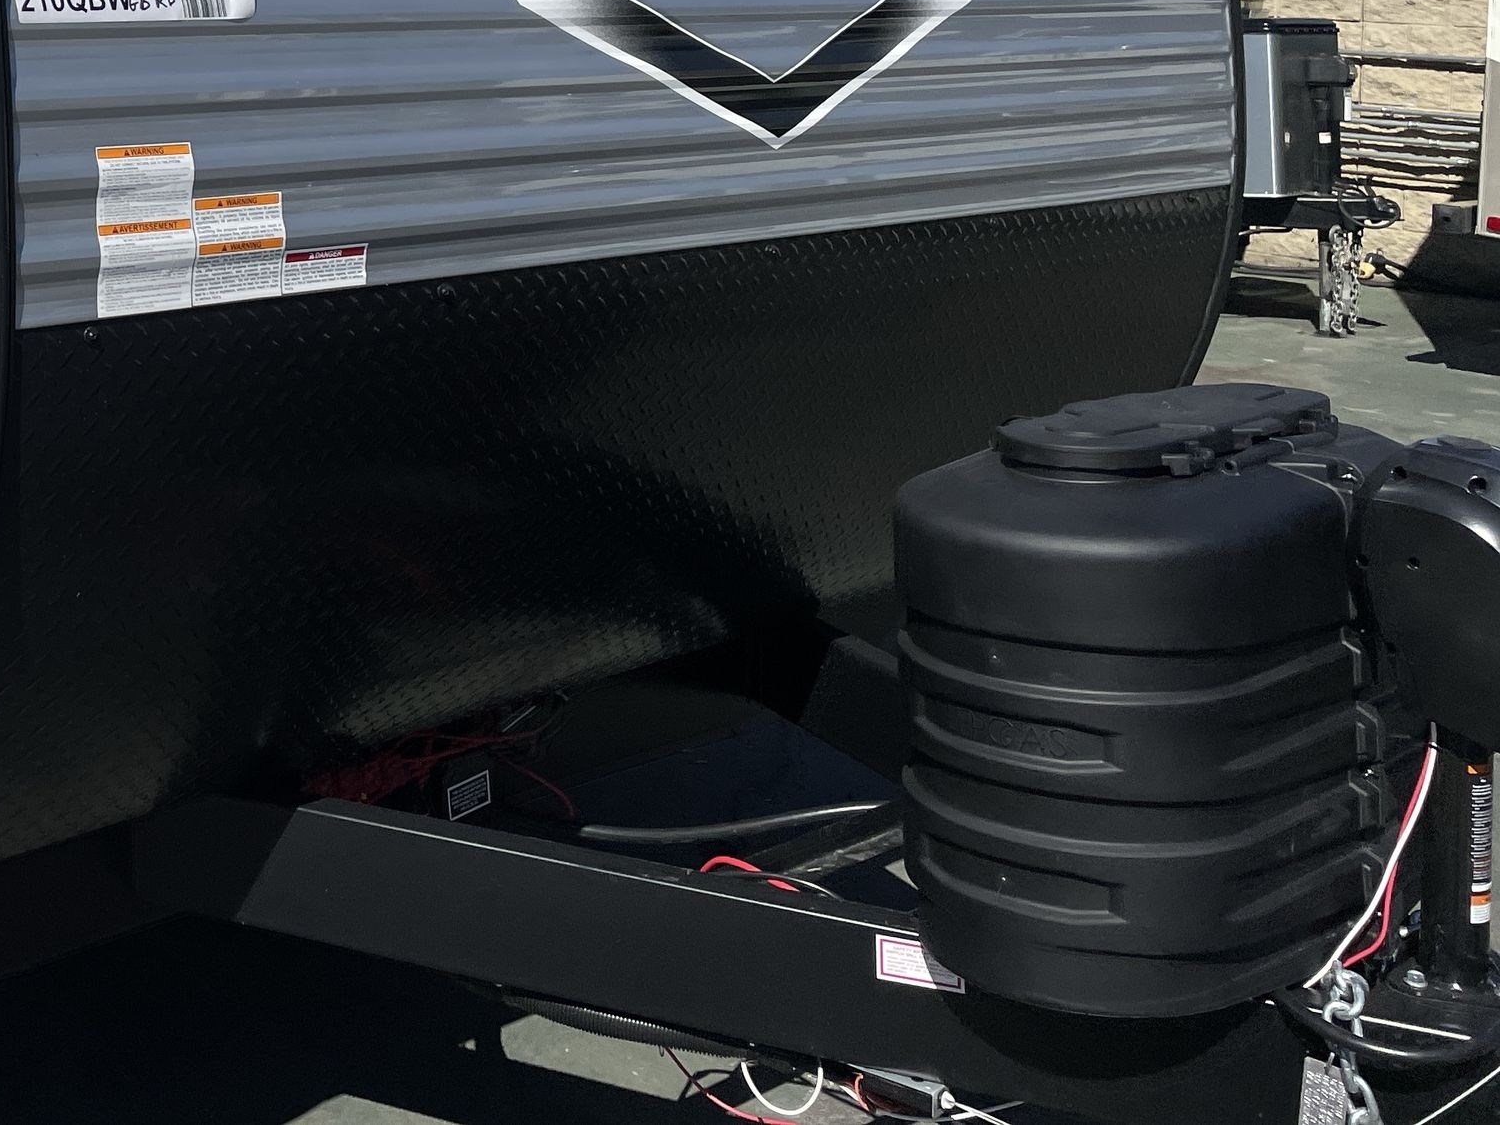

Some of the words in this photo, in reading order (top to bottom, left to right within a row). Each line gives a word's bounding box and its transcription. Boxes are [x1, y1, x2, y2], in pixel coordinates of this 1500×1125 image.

[130, 146, 165, 156] WARNING
[226, 197, 258, 206] WARNING
[119, 221, 178, 233] AVERTISSEMENT
[230, 241, 262, 250] WARNING
[315, 249, 343, 260] DANGER
